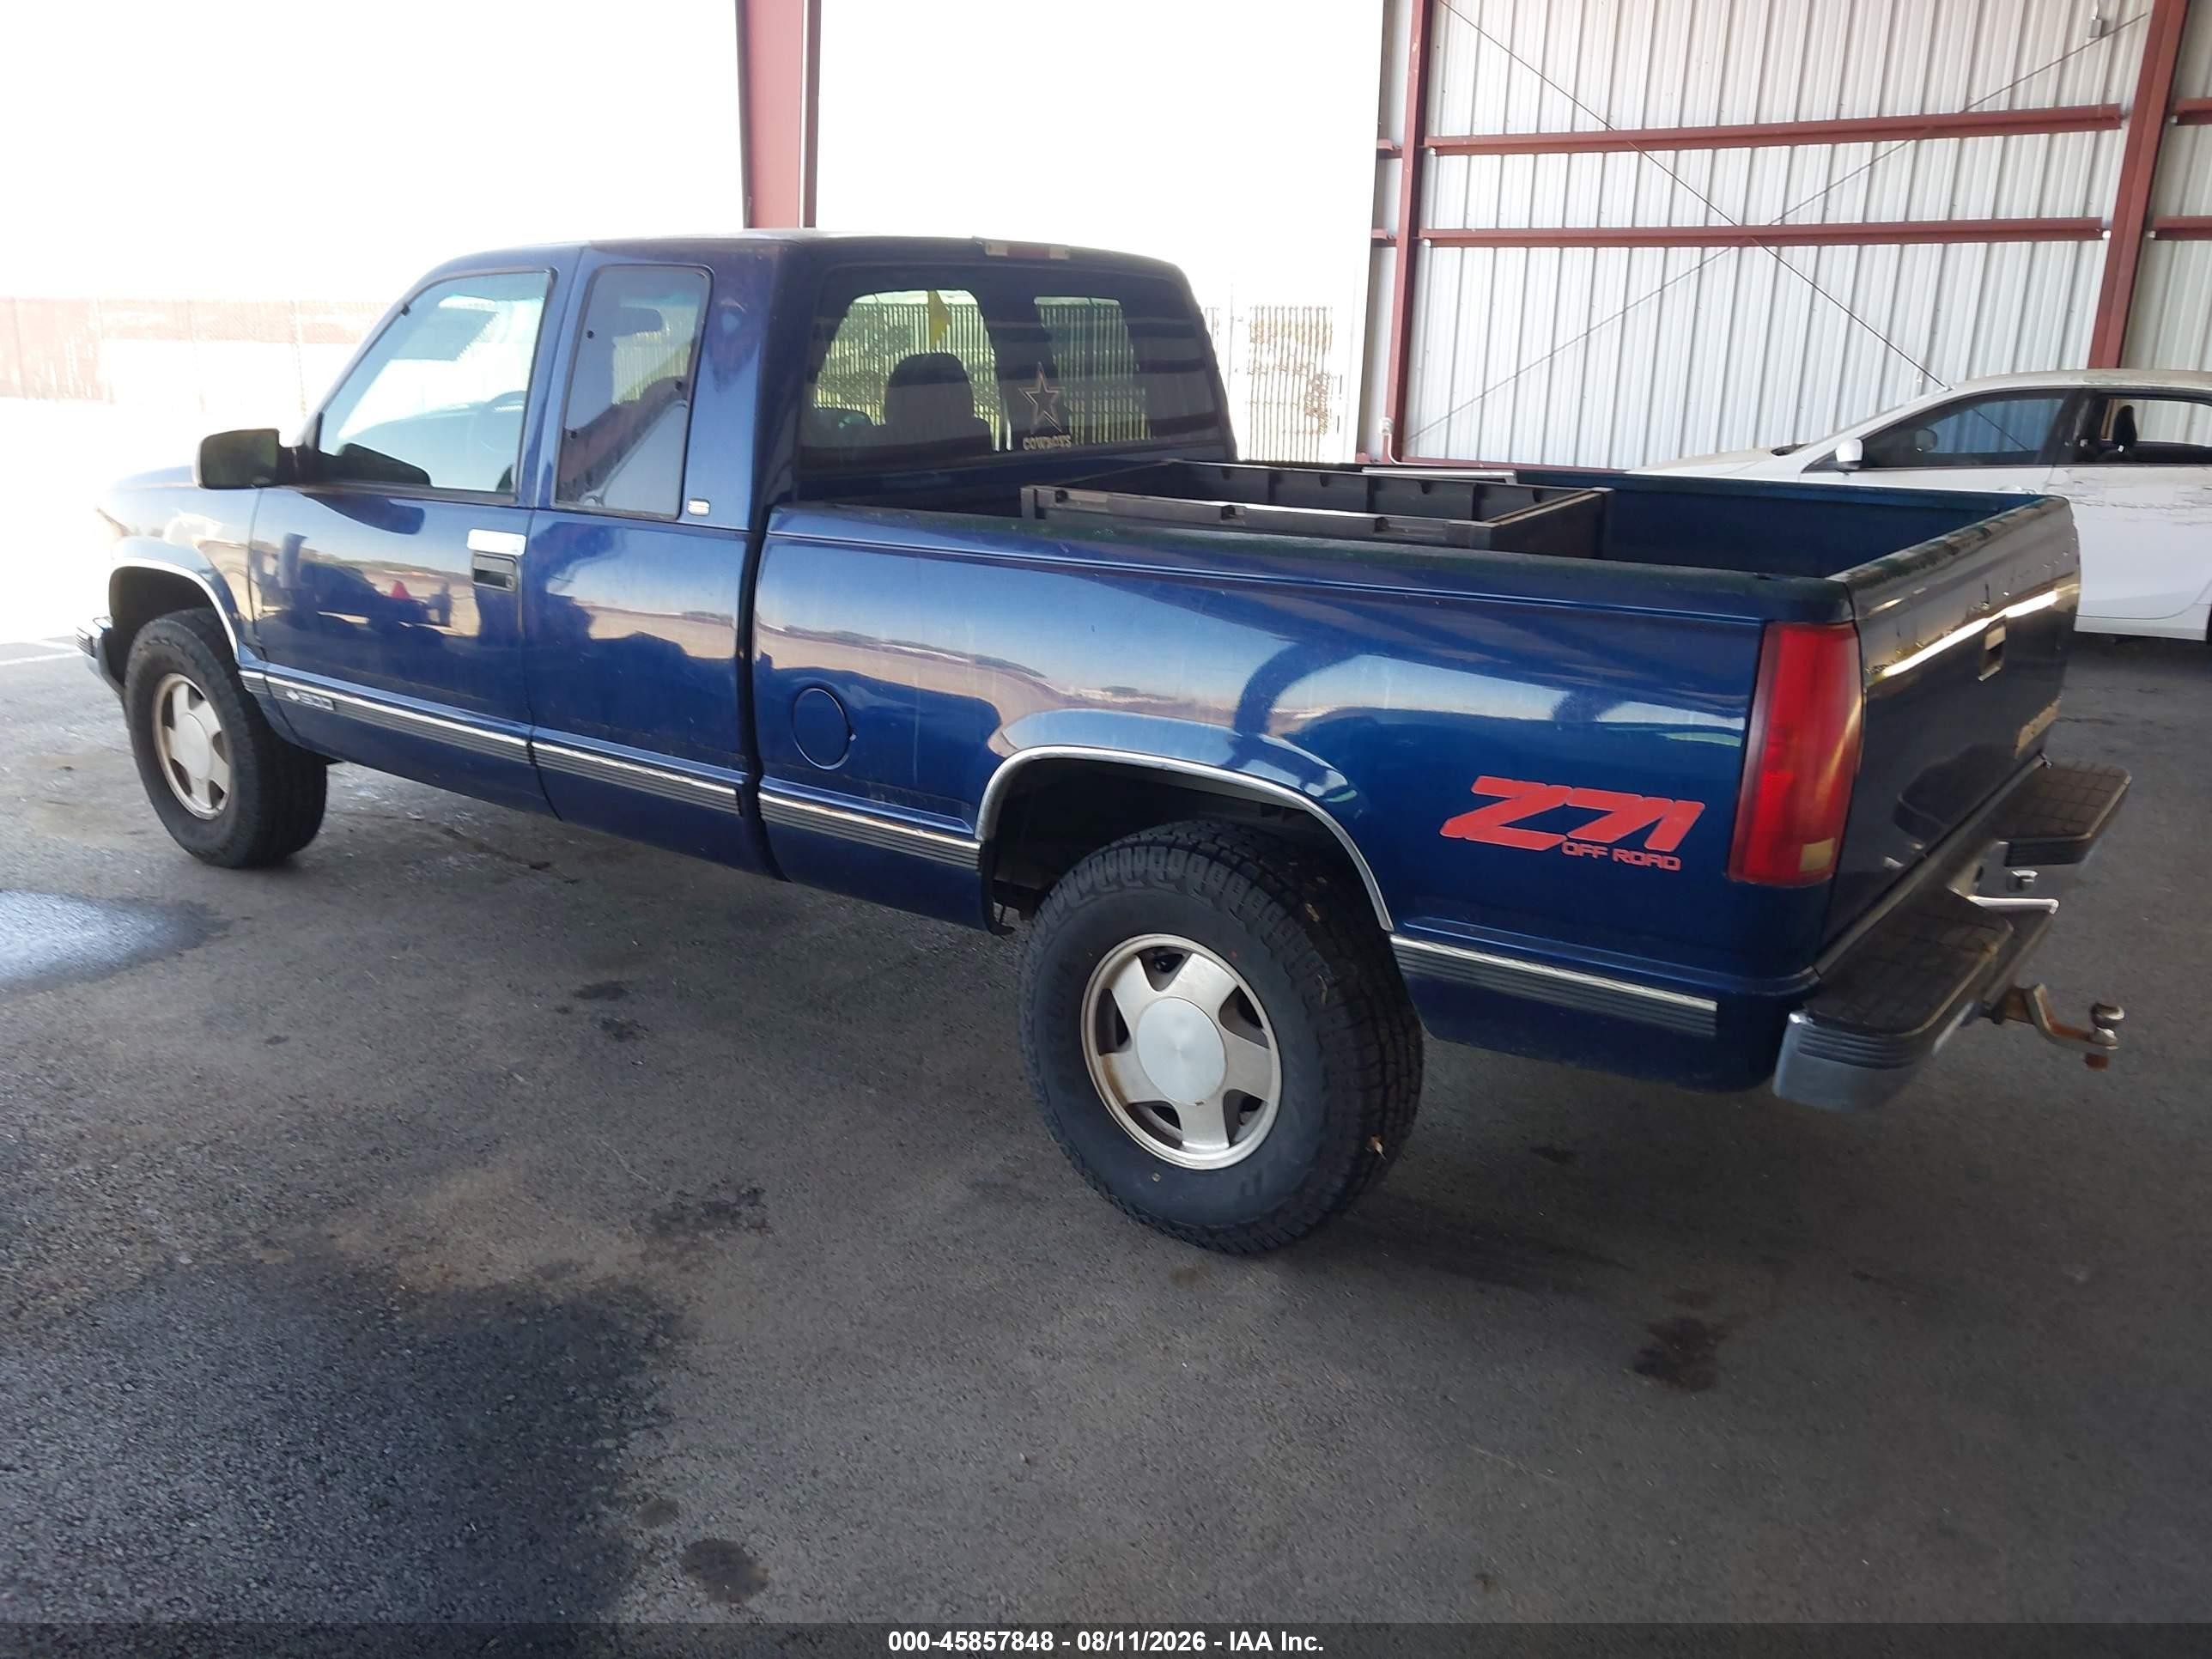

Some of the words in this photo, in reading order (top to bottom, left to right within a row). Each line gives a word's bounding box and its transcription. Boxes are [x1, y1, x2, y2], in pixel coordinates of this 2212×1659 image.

[1440, 775, 1705, 852] Z71
[1561, 841, 1608, 859] OFF
[1612, 848, 1681, 872] ROAD
